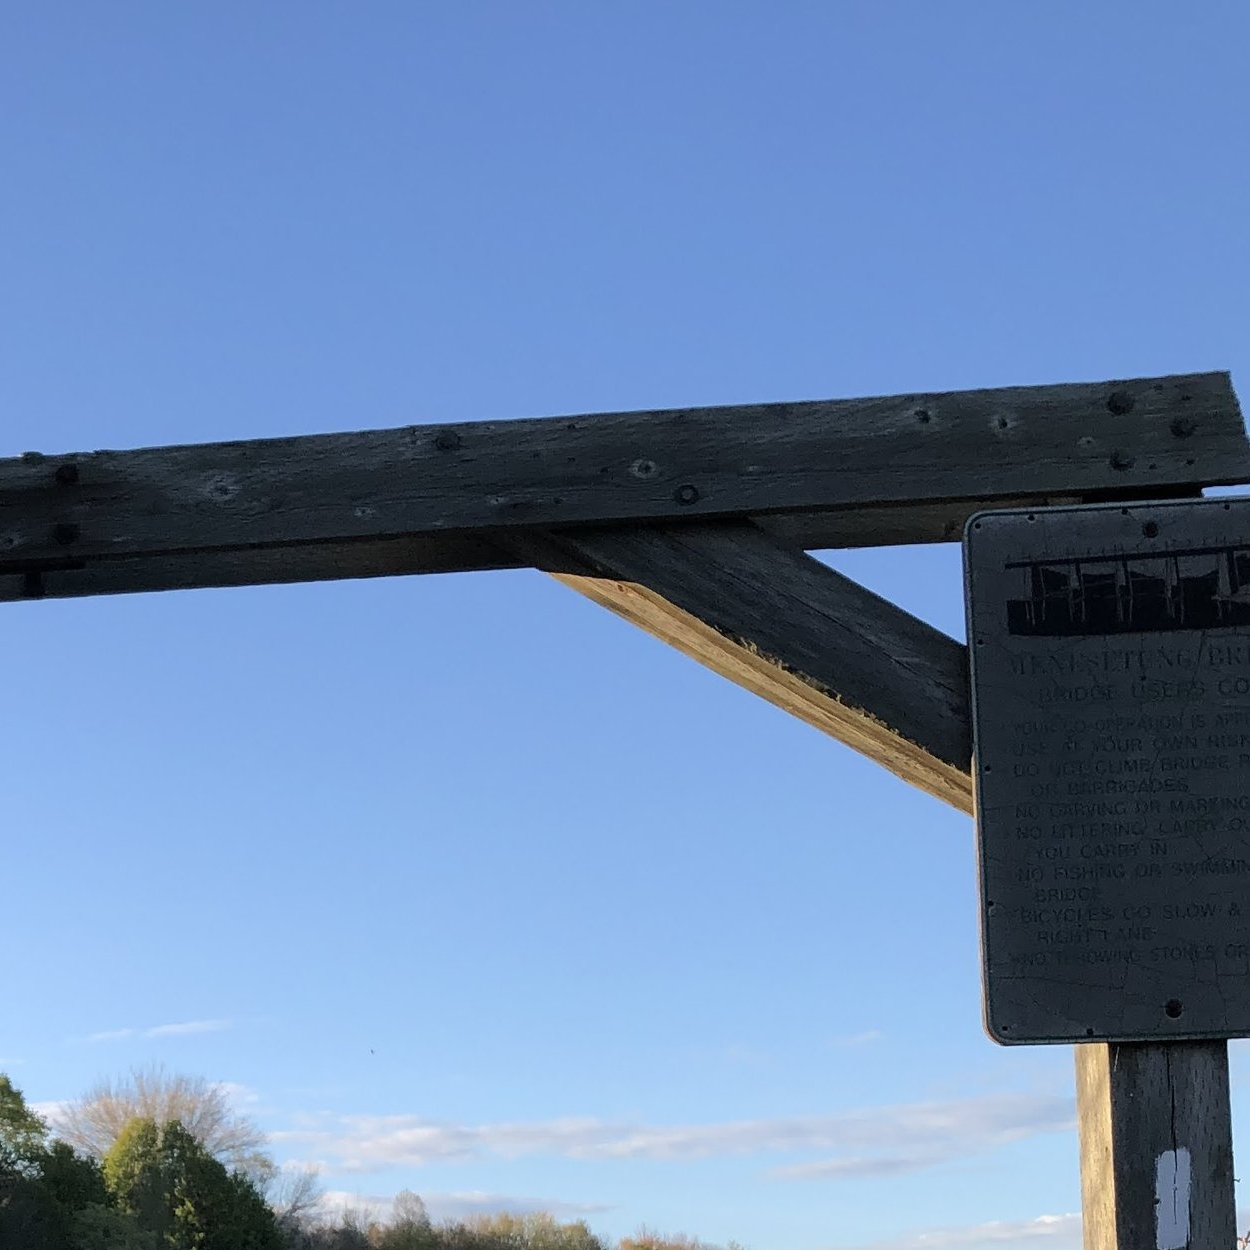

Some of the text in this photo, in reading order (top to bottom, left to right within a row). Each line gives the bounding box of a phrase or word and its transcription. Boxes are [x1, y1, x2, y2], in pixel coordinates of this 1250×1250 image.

[1095, 760, 1152, 775] CLIMB
[1015, 803, 1040, 819] NO
[1016, 825, 1042, 840] NO
